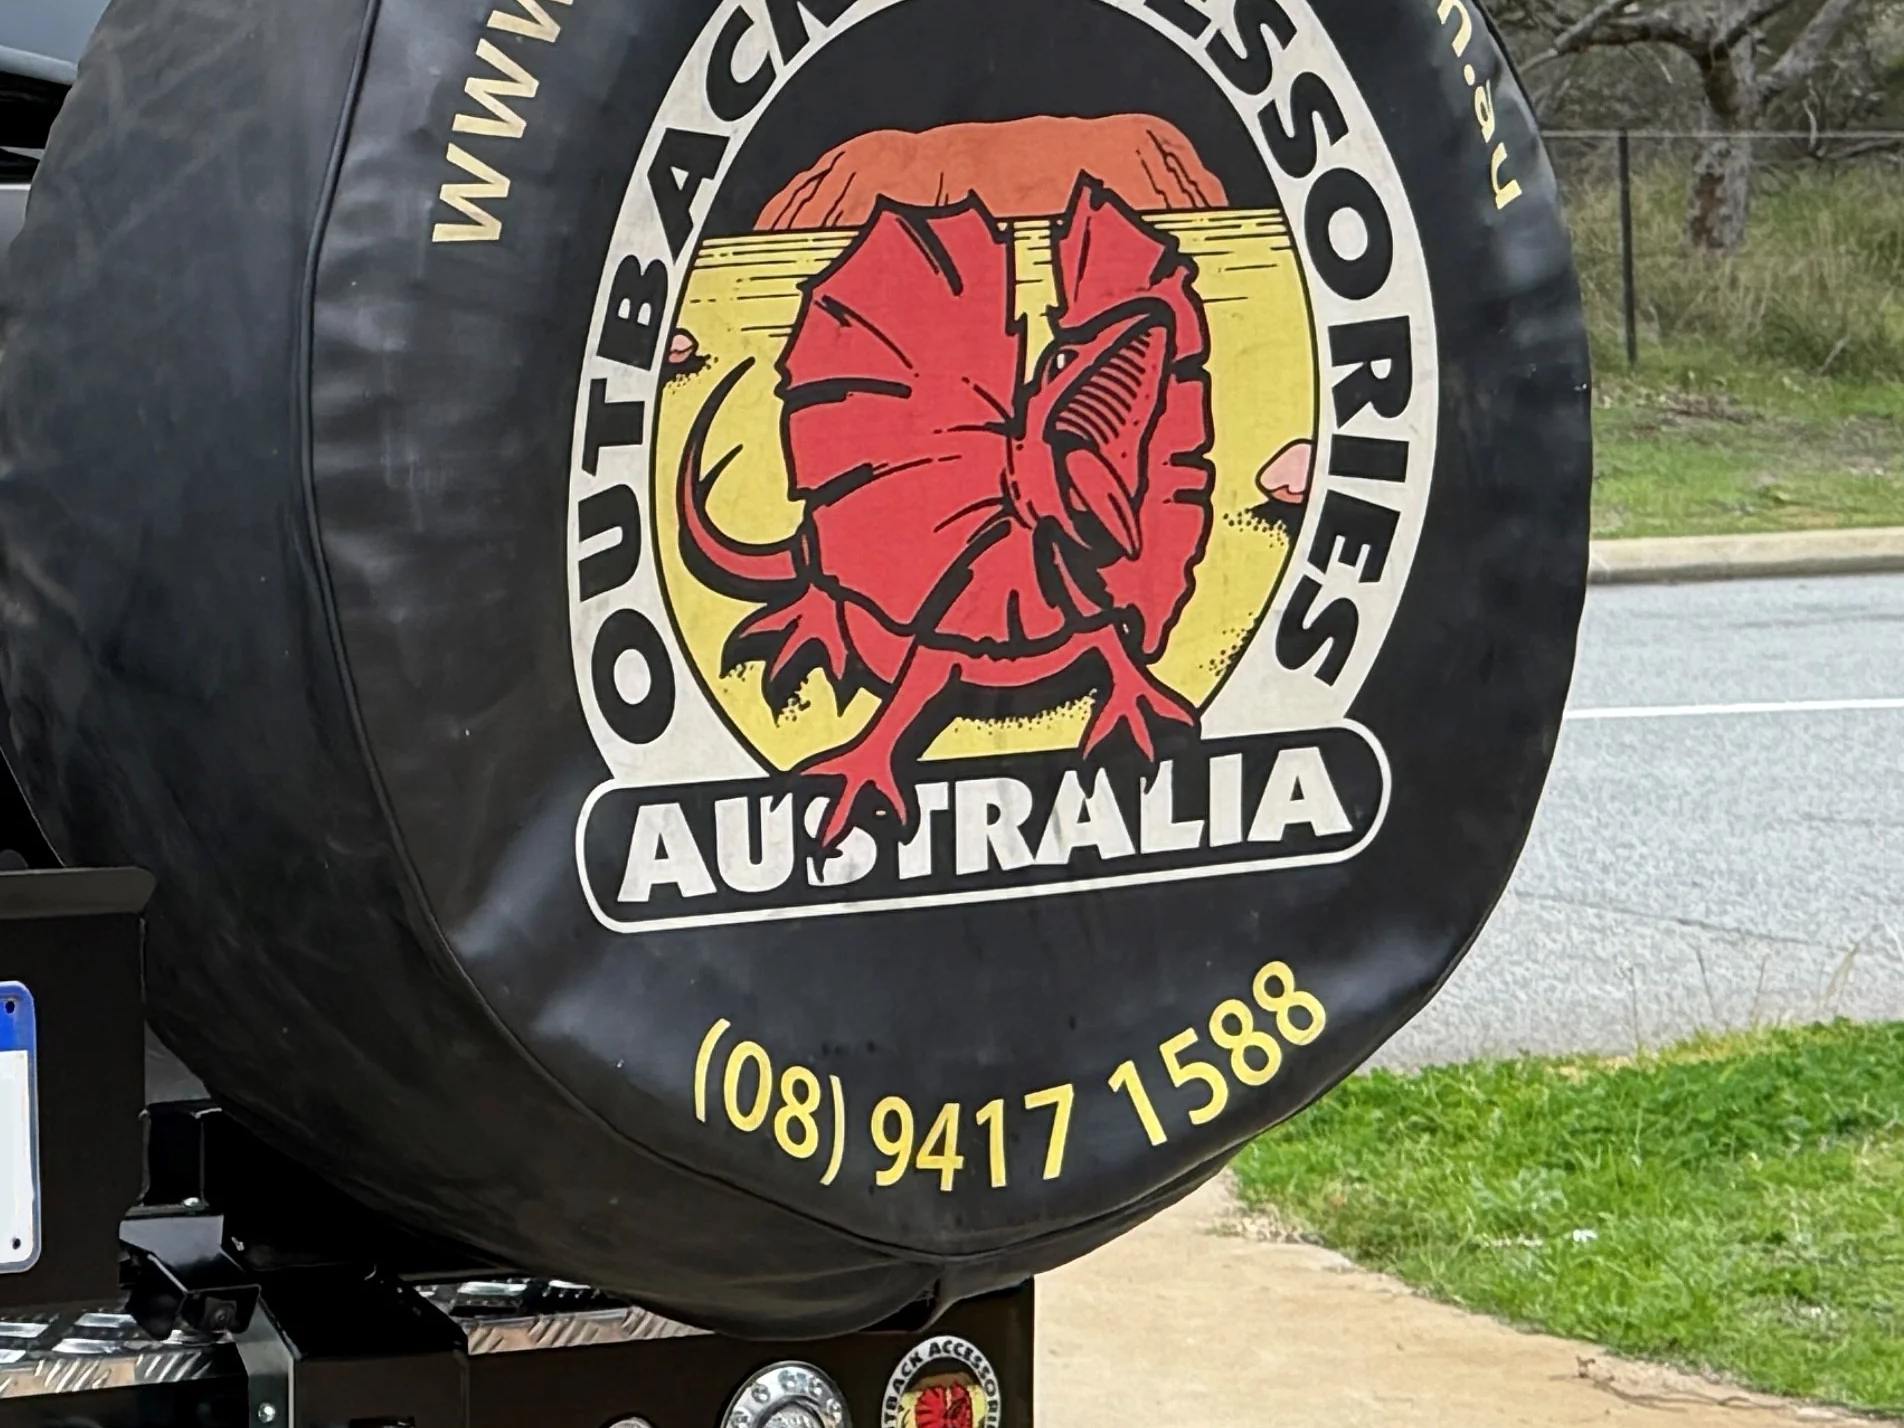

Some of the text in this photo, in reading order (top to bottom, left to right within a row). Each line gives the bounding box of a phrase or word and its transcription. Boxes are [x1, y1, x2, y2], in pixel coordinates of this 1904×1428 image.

[618, 746, 1355, 904] AUSTRALIA
[693, 961, 1327, 1192] (08) 9417 1588
